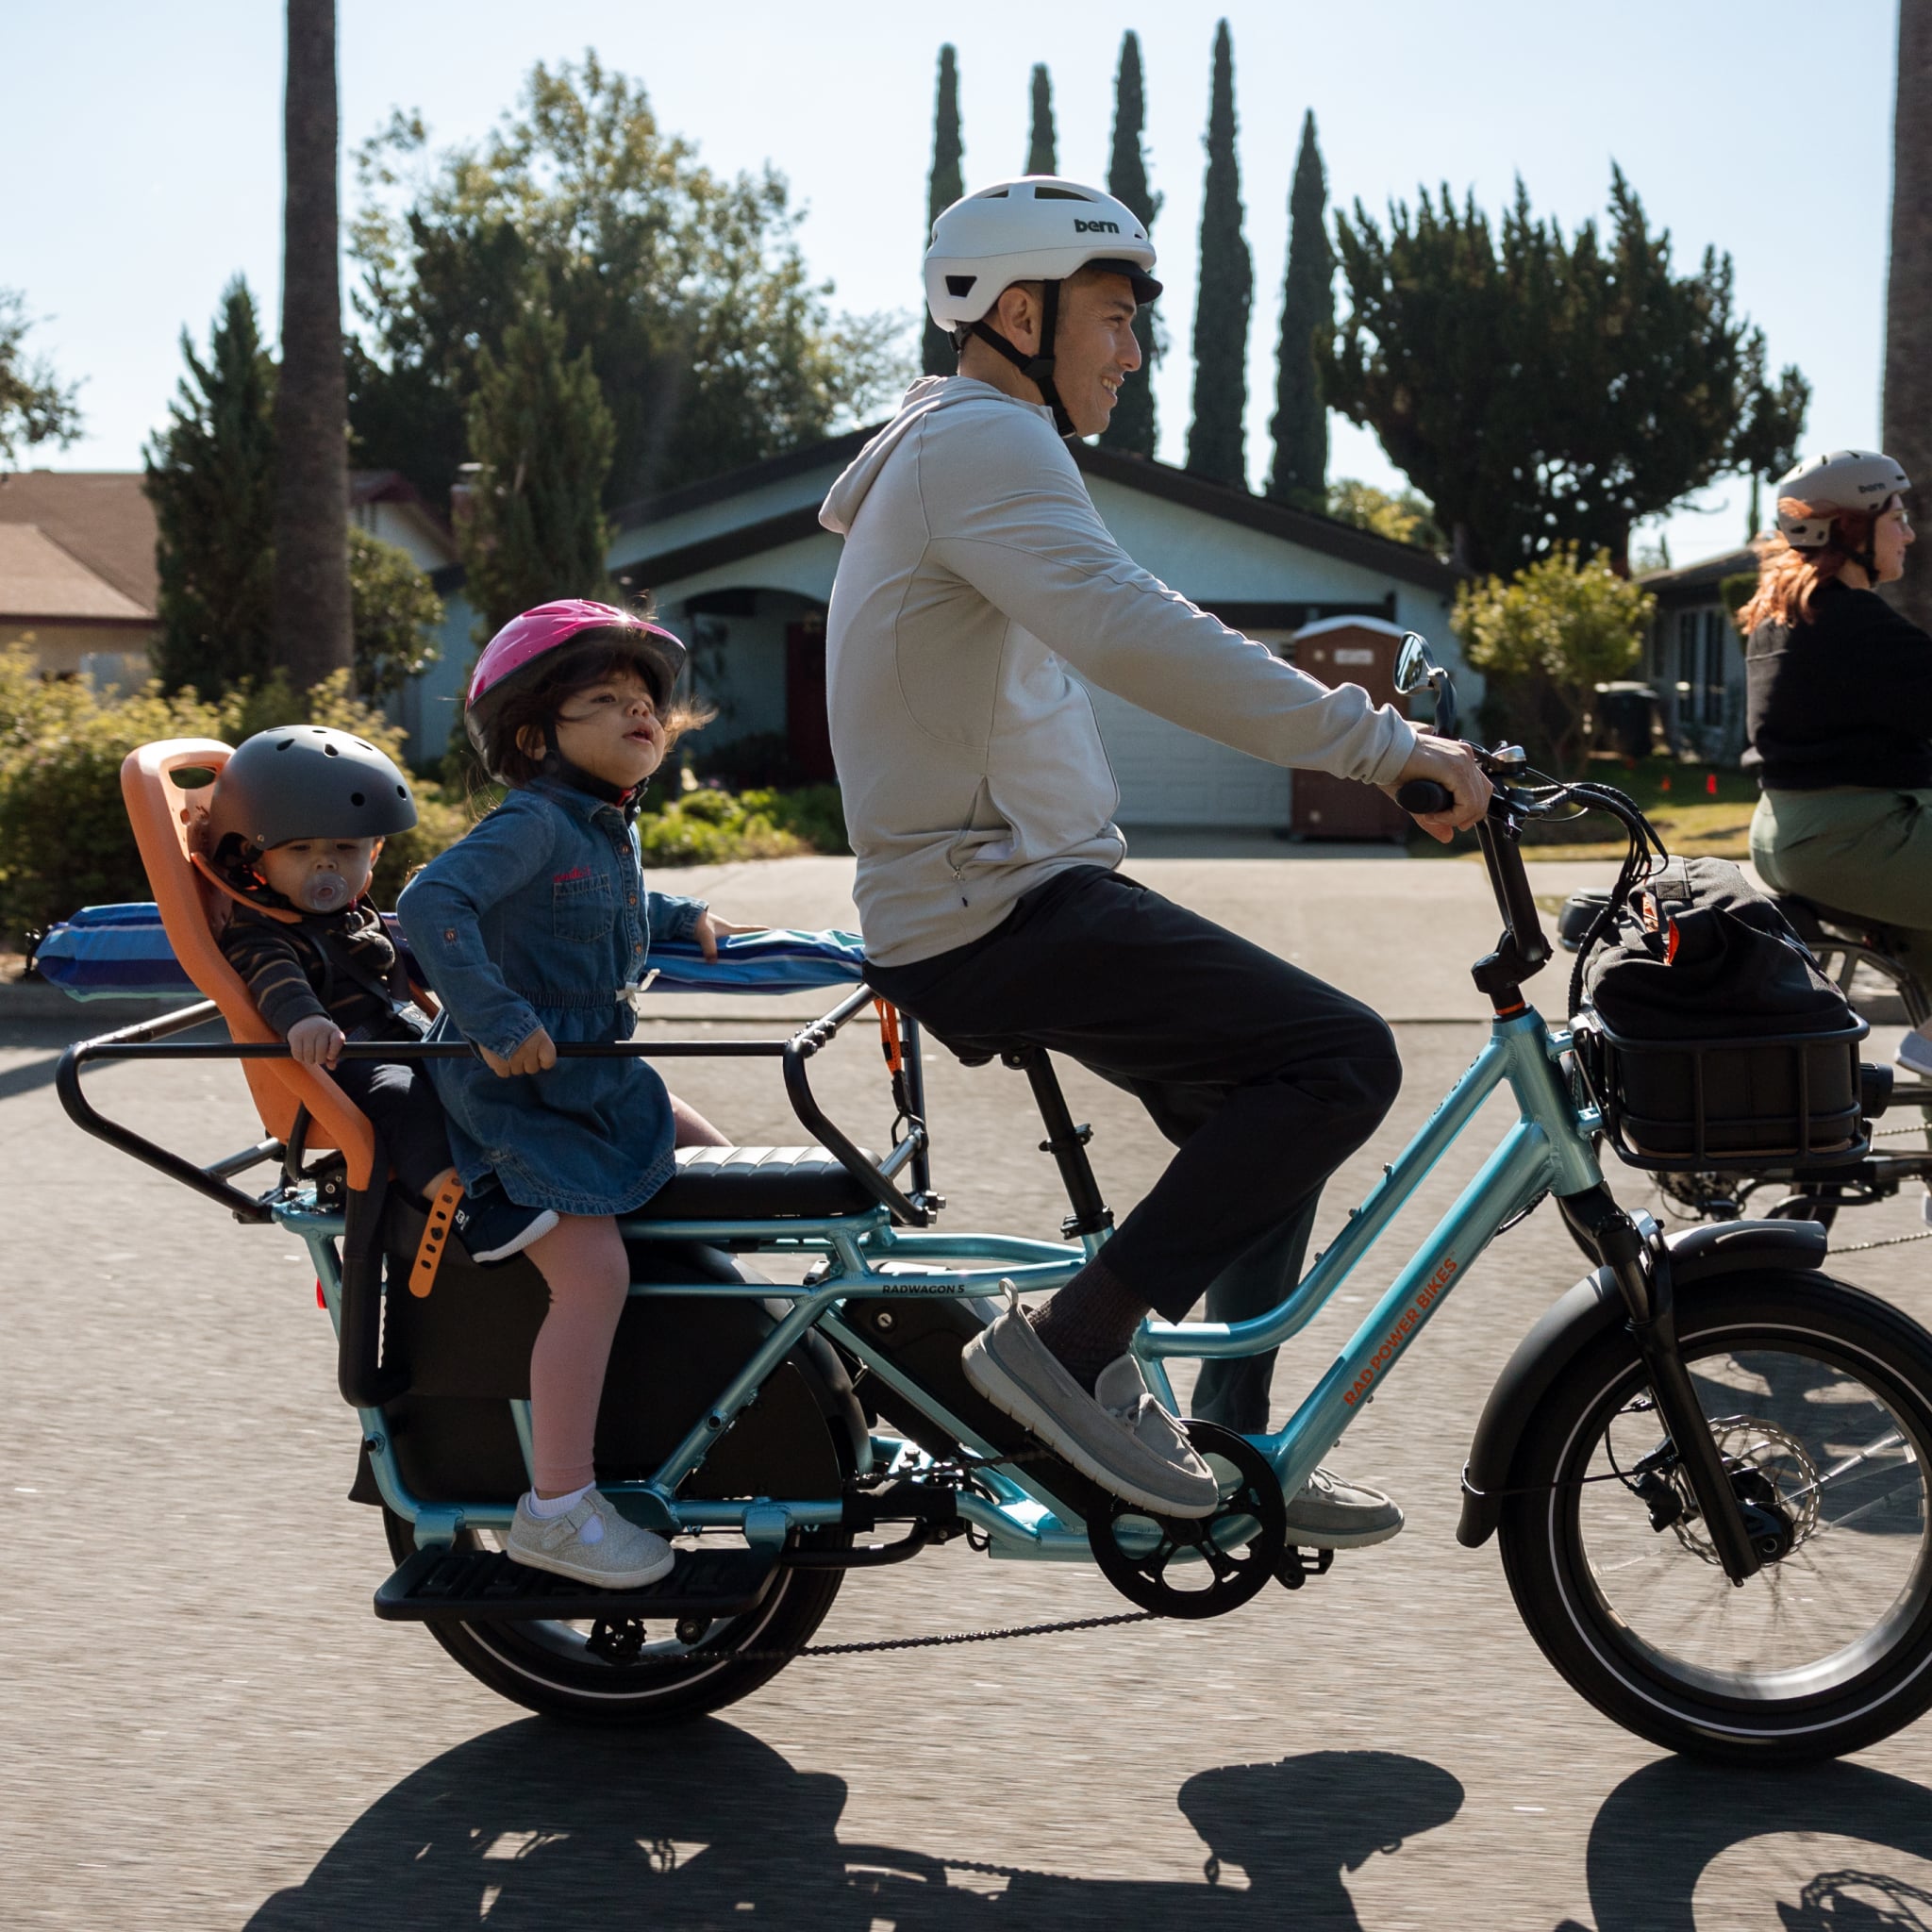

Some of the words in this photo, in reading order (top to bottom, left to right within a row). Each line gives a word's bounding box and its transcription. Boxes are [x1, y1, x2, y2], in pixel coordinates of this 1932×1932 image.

[1074, 219, 1120, 234] bern
[882, 1285, 955, 1294] RADWAGON
[958, 1284, 965, 1293] 5
[1342, 1368, 1374, 1407] RAD
[1370, 1307, 1420, 1371] POWER
